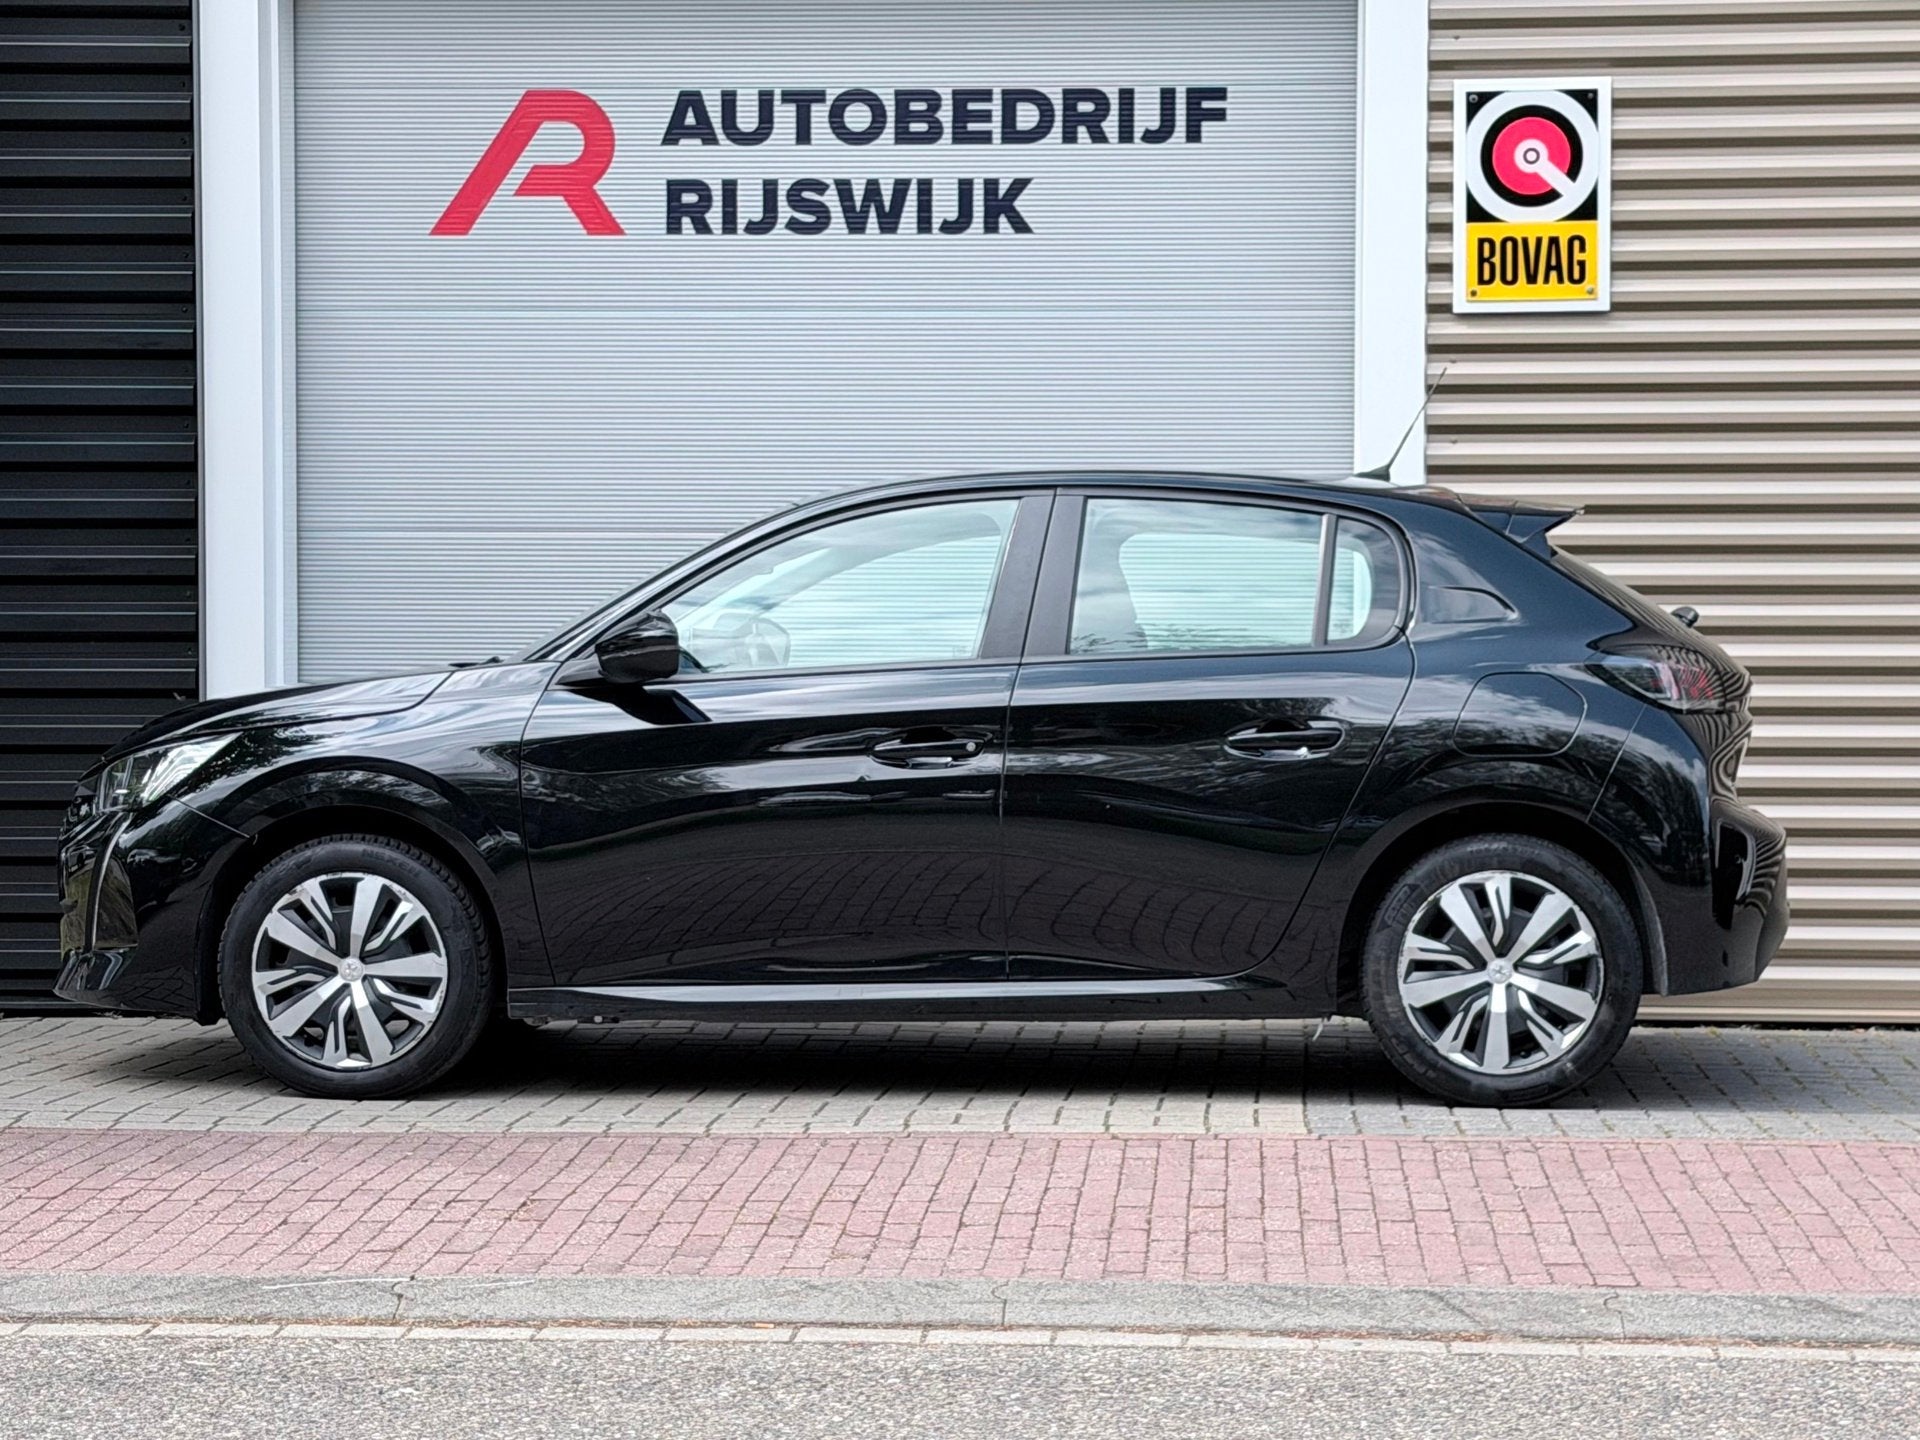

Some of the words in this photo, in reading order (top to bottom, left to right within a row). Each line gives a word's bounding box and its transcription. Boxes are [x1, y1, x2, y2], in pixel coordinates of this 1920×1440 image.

[661, 87, 1228, 146] AUTOBEDRIJF
[667, 179, 1032, 235] RIJSWIJK
[1477, 235, 1586, 286] BOVAG
